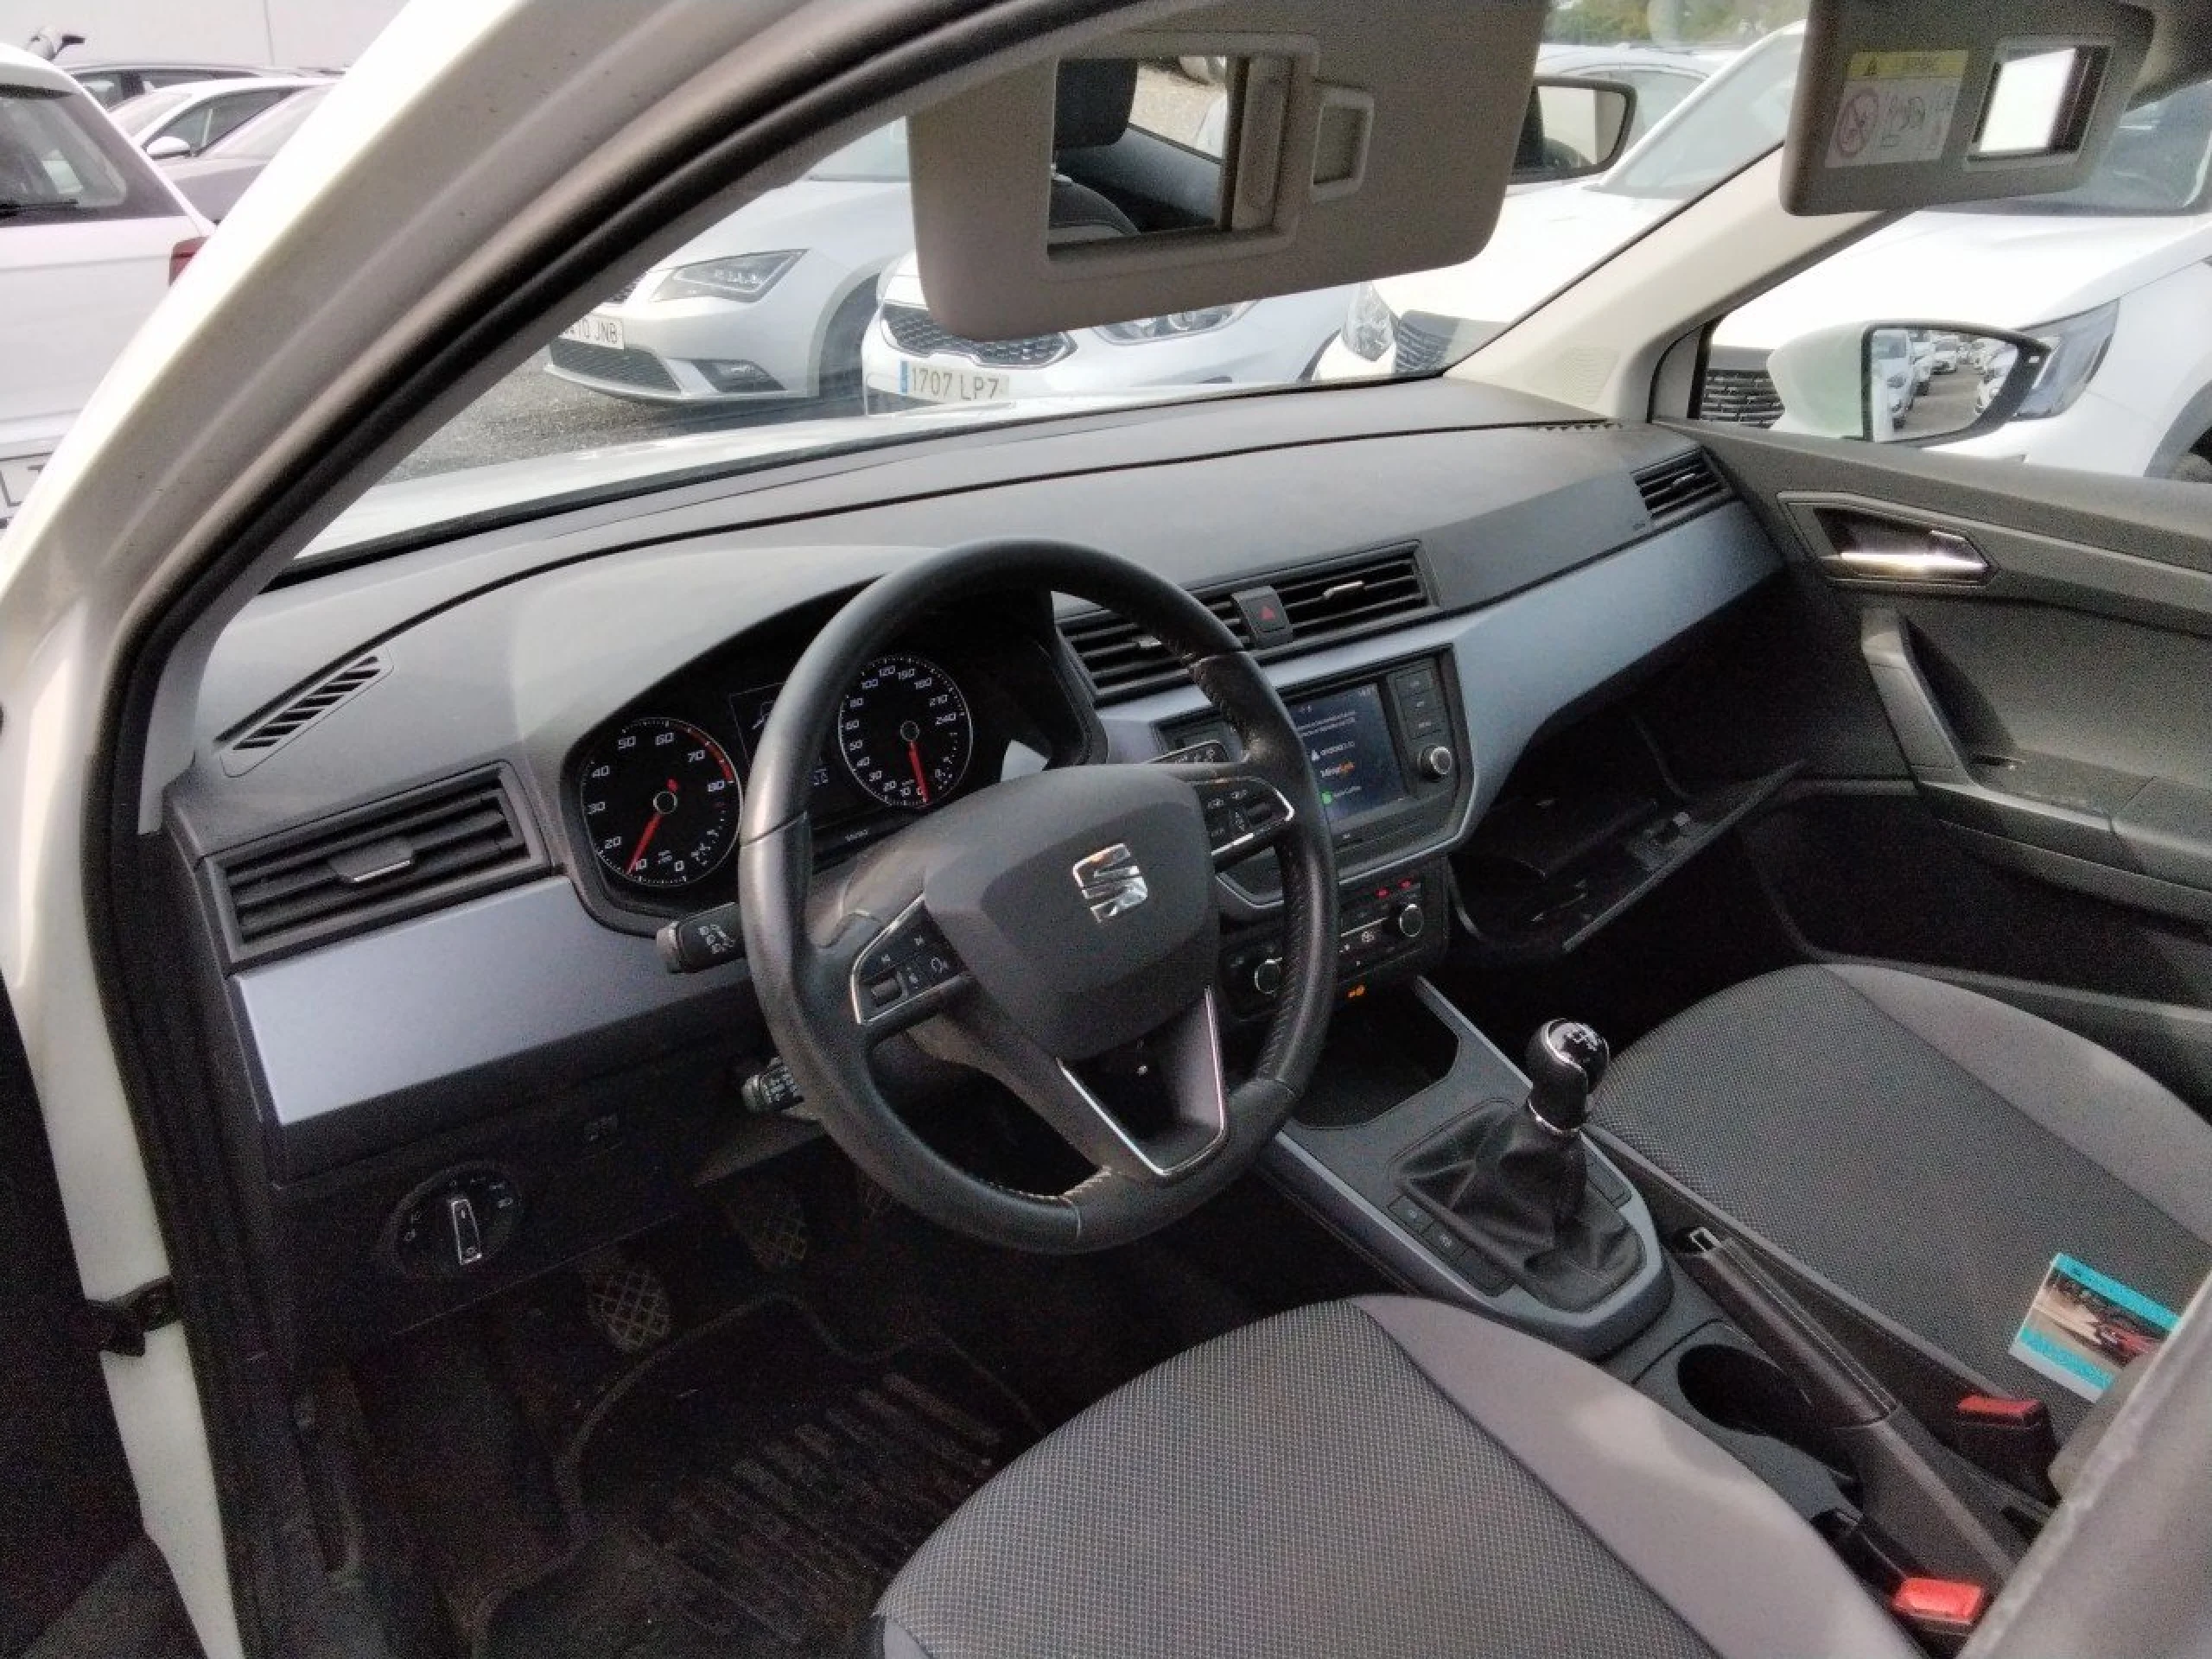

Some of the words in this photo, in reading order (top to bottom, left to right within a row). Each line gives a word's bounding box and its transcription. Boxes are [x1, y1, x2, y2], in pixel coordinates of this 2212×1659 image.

[912, 367, 952, 399] 1707
[935, 712, 957, 726] 240
[618, 735, 637, 751] 50
[655, 732, 674, 746] 60
[687, 749, 705, 762] 70
[592, 765, 611, 779] 40
[588, 801, 606, 815] 30
[604, 836, 622, 849] 20
[673, 860, 684, 872] 0
